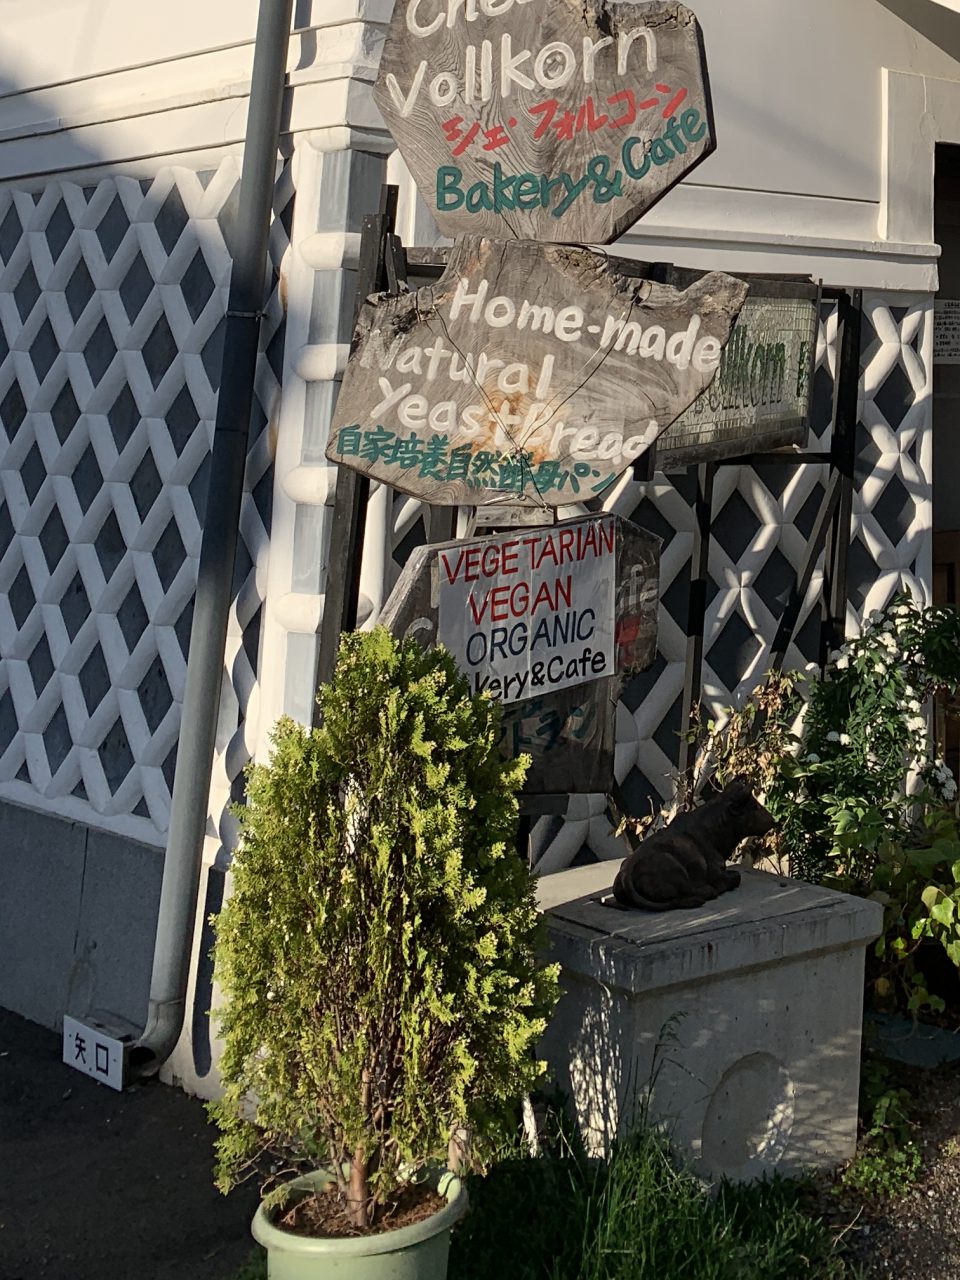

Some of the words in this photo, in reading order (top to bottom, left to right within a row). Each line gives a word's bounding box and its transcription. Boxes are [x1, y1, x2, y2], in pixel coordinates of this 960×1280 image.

[386, 27, 656, 117] Vollkorn
[450, 277, 722, 373] Home-made
[359, 328, 554, 399] Natural
[369, 376, 520, 447] Yeast
[516, 402, 658, 464] Bread
[441, 520, 615, 585] VEGETARIAN
[469, 575, 573, 626] VEGAN
[466, 608, 595, 666] ORGANIC
